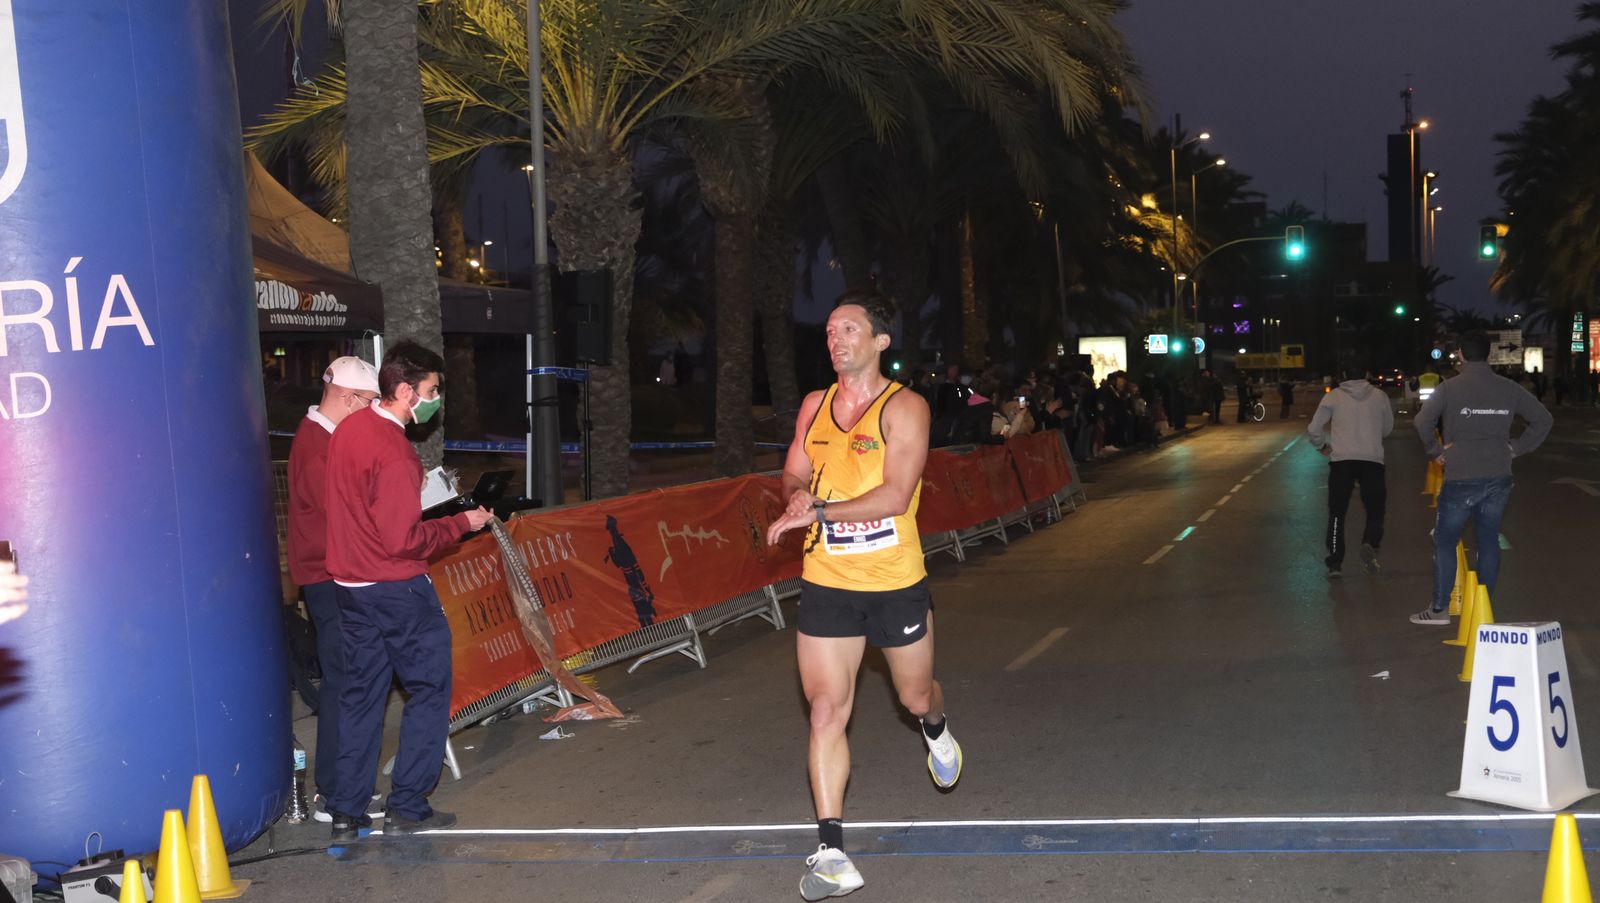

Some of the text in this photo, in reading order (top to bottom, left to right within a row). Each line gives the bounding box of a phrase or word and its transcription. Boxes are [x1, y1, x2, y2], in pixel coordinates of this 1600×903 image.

[0, 256, 156, 357] RÍA
[1479, 630, 1528, 645] MONDO
[1537, 627, 1561, 645] MONDO
[1486, 675, 1520, 752] 5
[1548, 671, 1568, 749] 5
